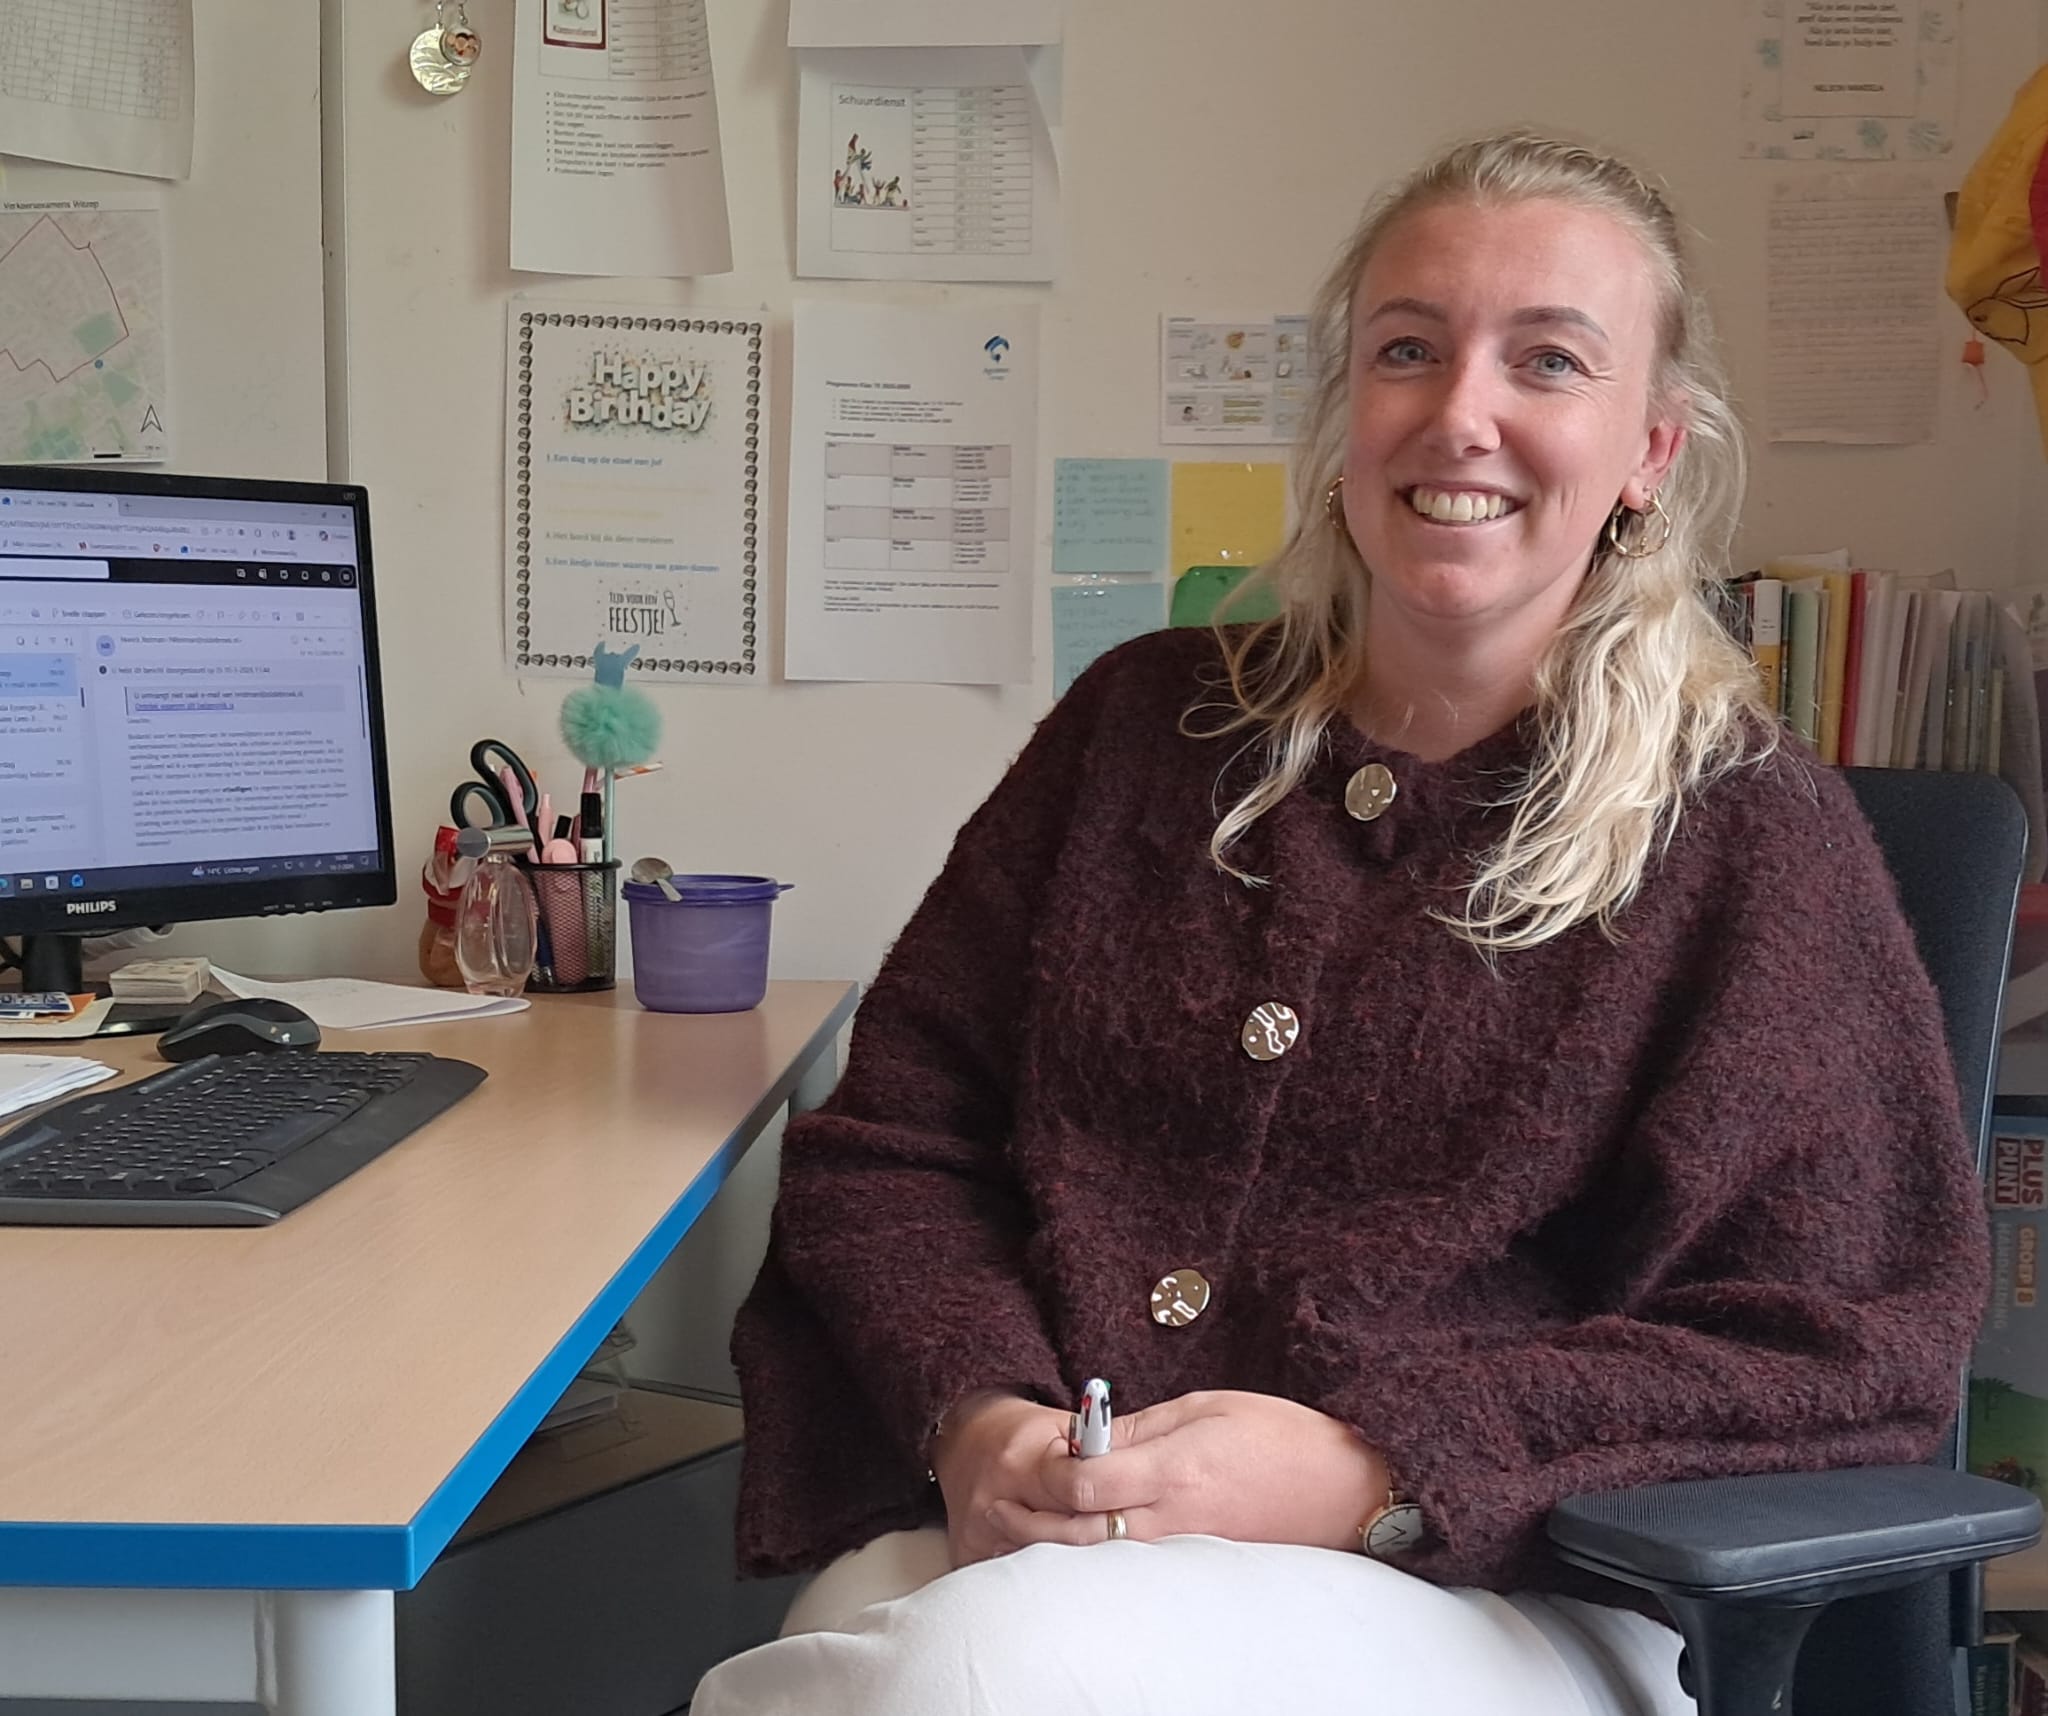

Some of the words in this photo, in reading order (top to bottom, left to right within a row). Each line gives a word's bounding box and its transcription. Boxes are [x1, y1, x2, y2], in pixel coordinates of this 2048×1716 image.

[838, 94, 907, 108] Schuurdienst
[593, 352, 707, 399] Happy
[566, 388, 712, 432] Birthday
[608, 606, 665, 637] FEESTJE!
[66, 900, 117, 915] PHILIPS
[1998, 1140, 2020, 1203] PUNT
[2021, 1138, 2046, 1205] PLUS
[2018, 1226, 2036, 1286] GROEP
